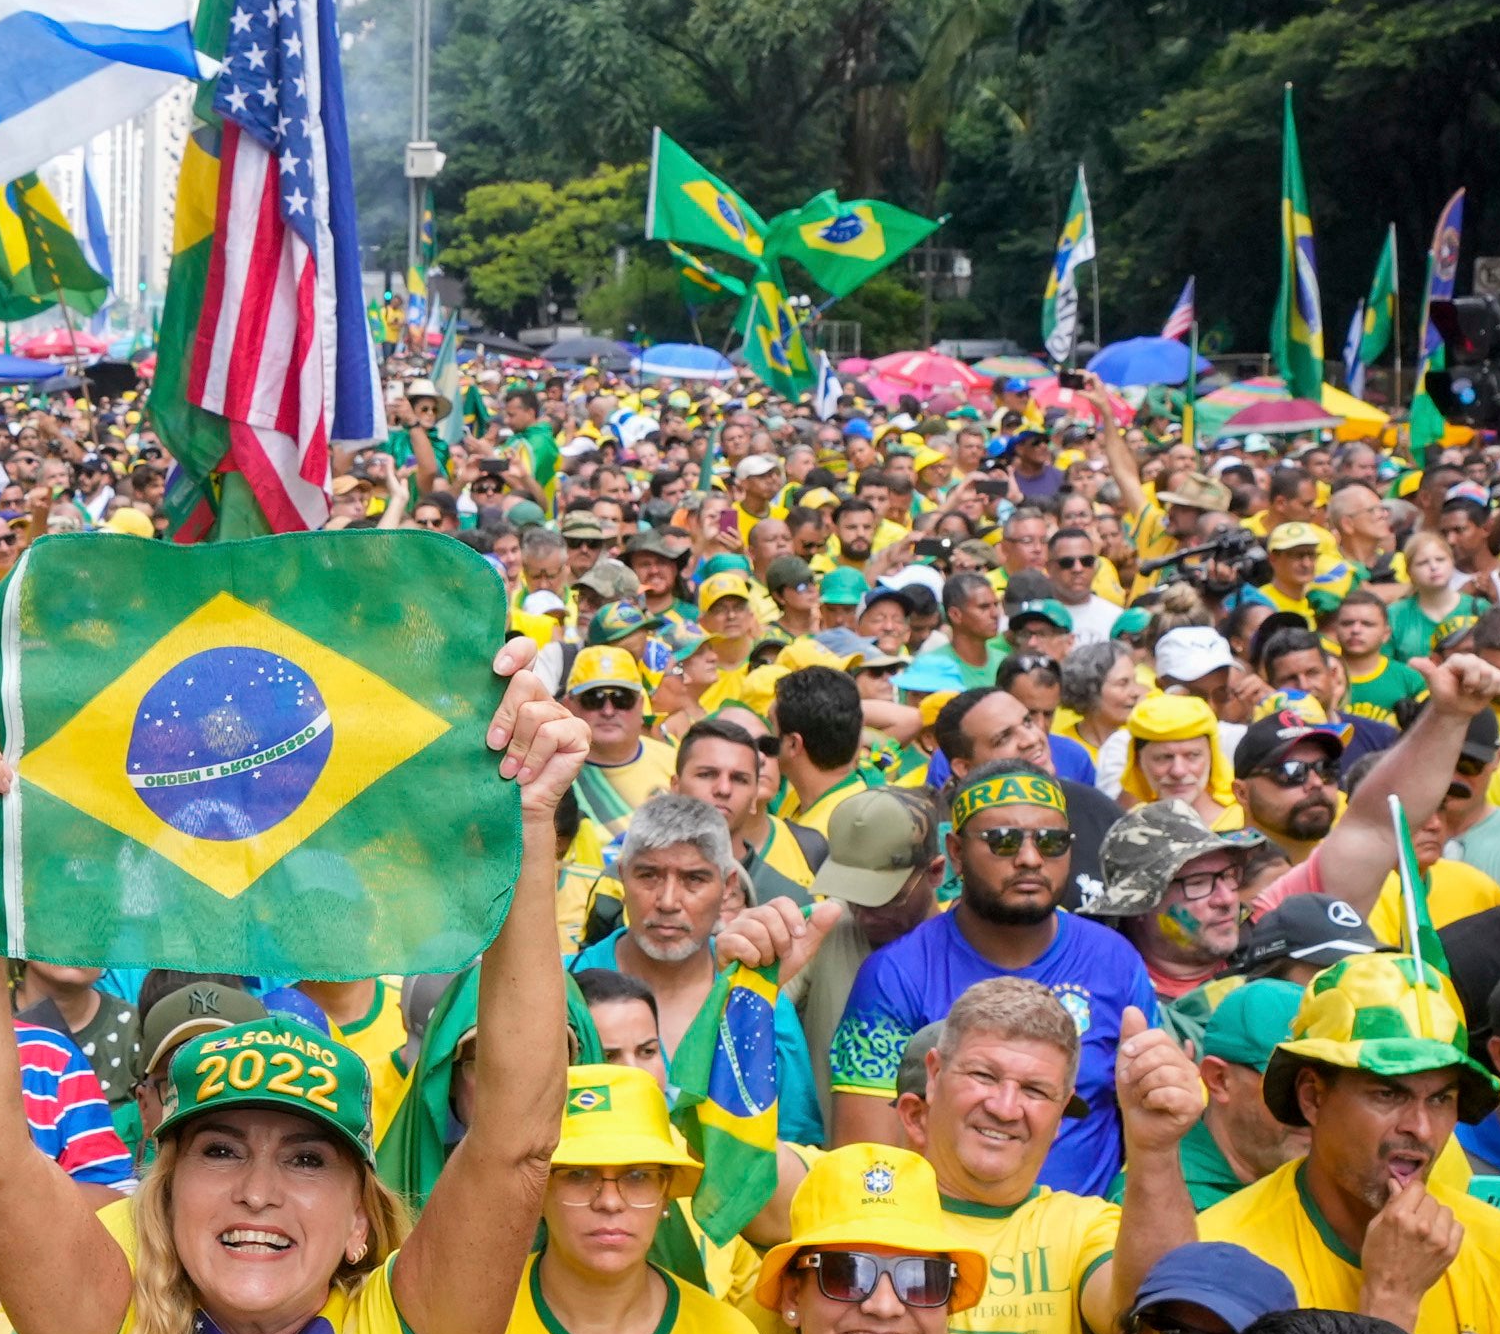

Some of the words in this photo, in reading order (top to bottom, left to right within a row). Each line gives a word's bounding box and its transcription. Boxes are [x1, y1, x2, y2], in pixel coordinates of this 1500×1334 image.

[200, 1030, 338, 1067] BOLSONARO
[195, 1049, 338, 1113] 2022
[861, 1196, 898, 1207] BRASIL
[988, 1246, 1071, 1297] SIL
